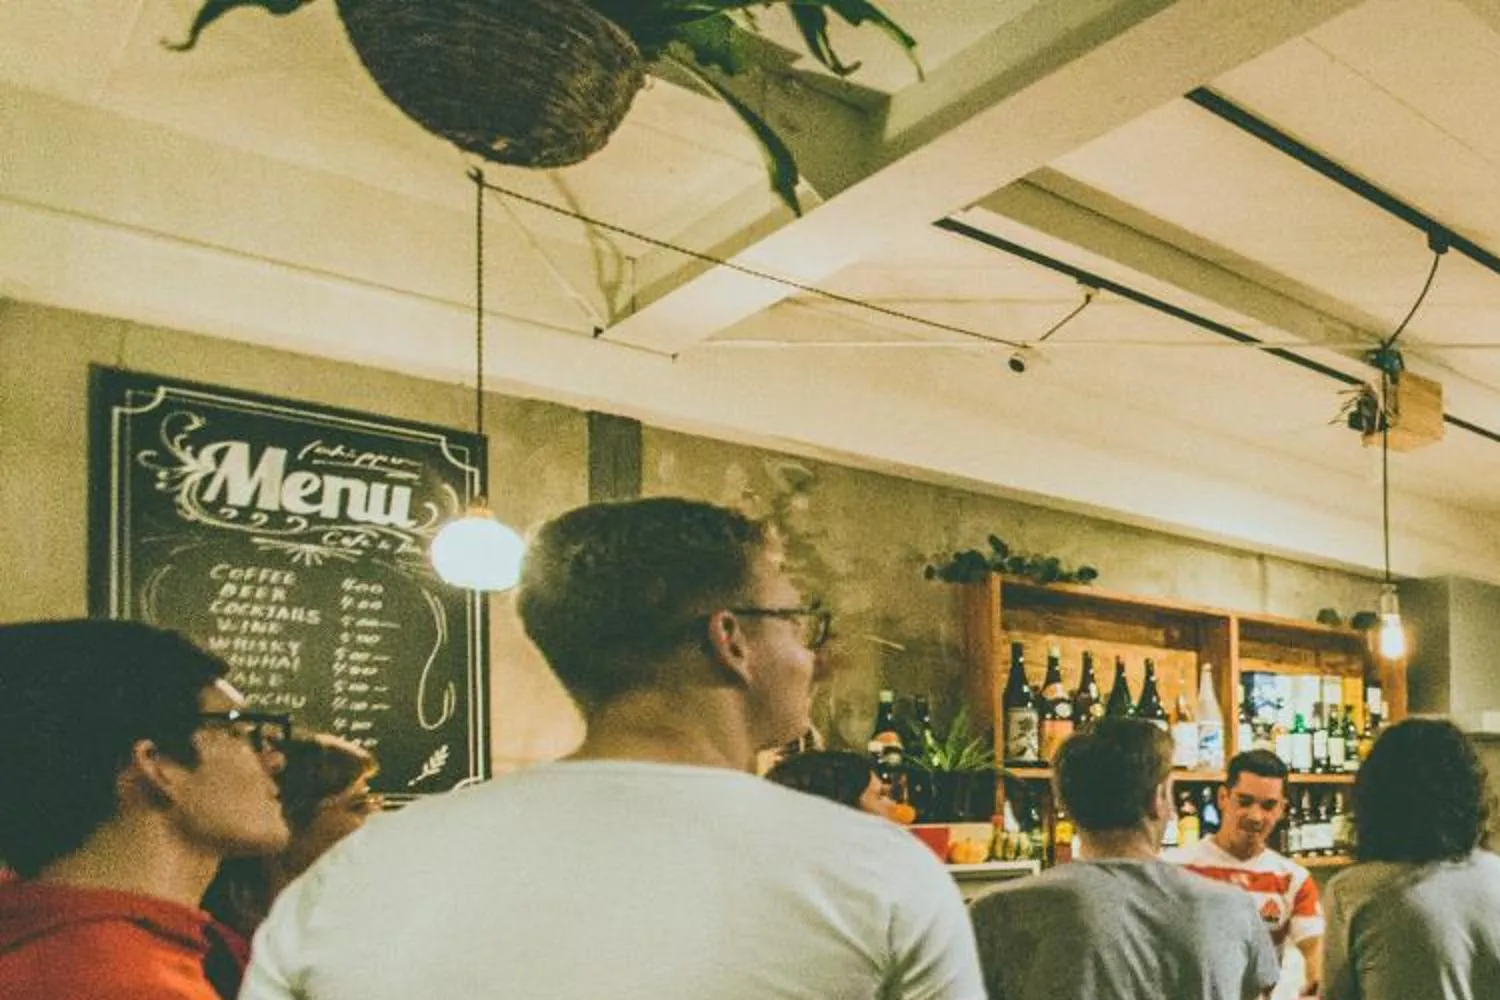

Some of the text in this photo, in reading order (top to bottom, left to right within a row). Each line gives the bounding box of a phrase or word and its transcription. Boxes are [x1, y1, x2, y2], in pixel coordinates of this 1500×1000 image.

[196, 440, 418, 529] Menu
[210, 563, 297, 585] COFFEE
[219, 581, 287, 601] BEER
[209, 599, 321, 625] COCKTAILS
[216, 617, 283, 634] WINE
[246, 692, 307, 708] OCHU
